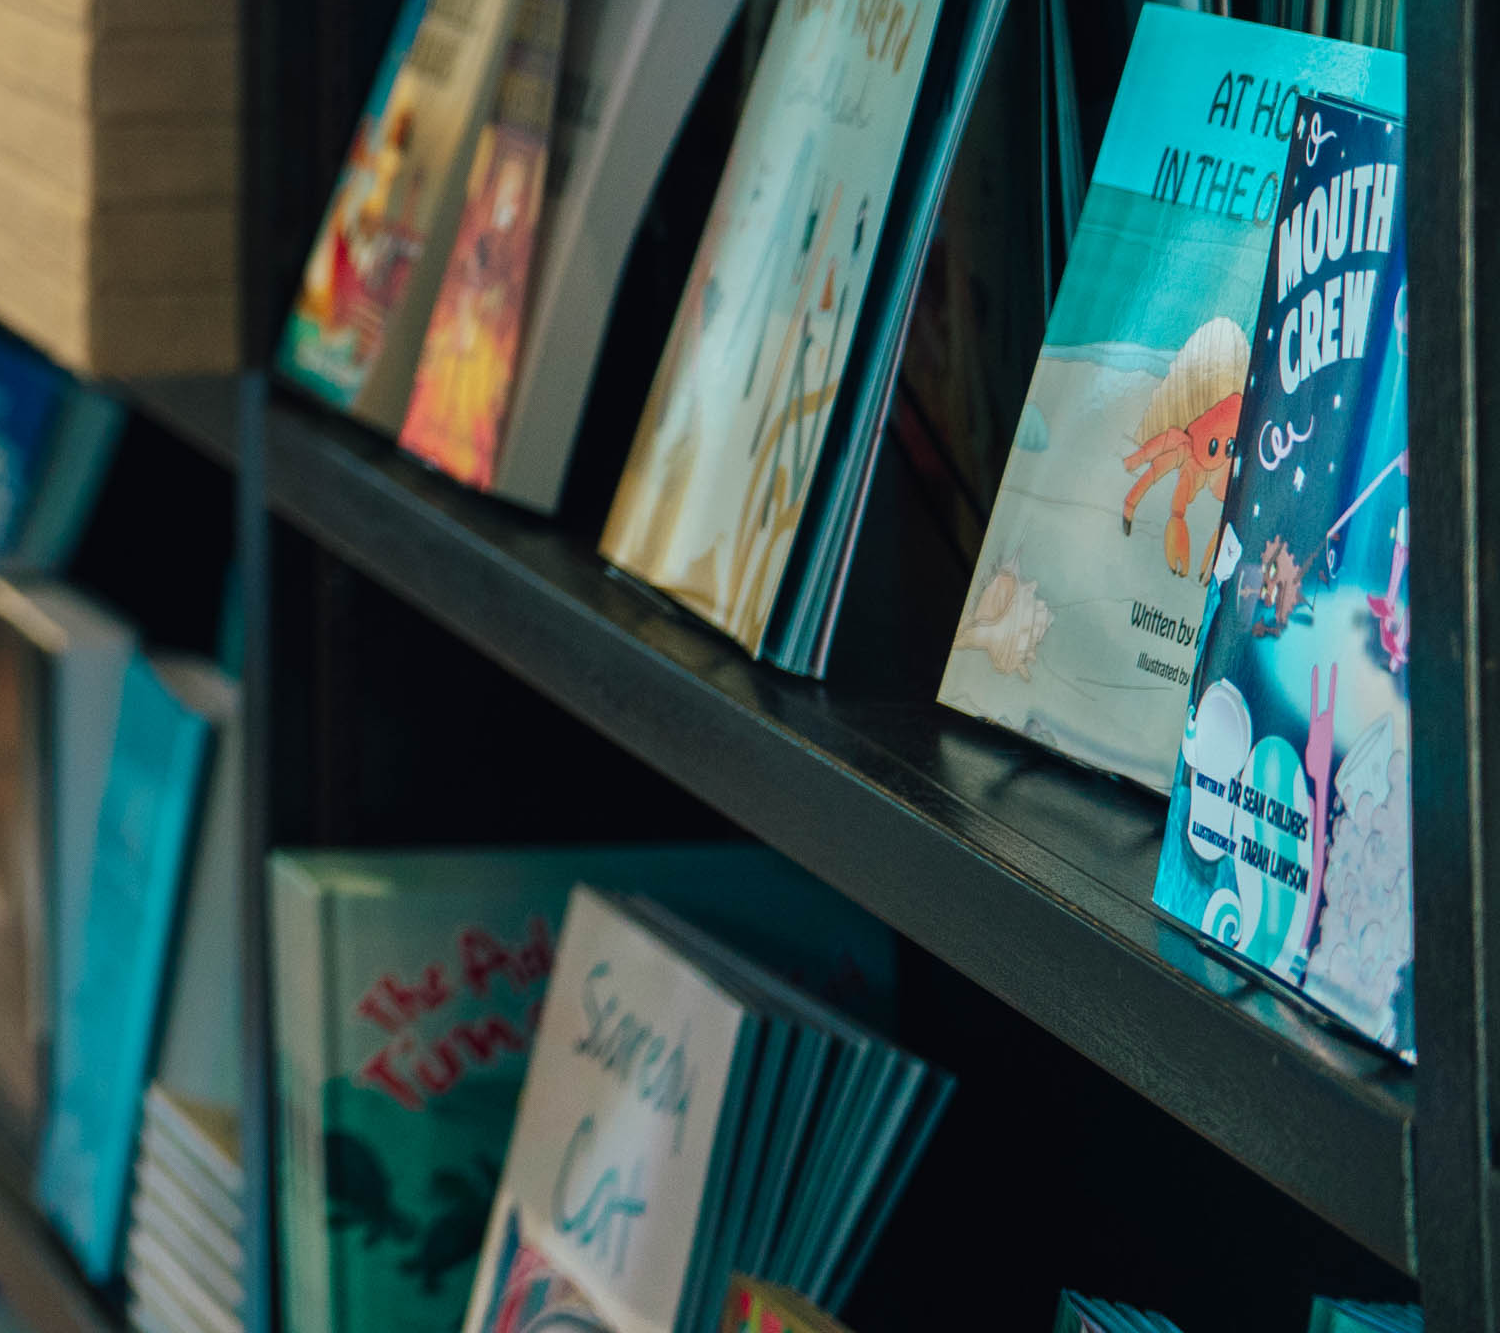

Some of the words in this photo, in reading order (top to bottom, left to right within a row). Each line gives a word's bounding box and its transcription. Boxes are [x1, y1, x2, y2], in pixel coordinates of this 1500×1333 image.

[1208, 70, 1254, 129] AT
[1251, 77, 1301, 142] HO
[1152, 146, 1191, 205] IN
[1190, 153, 1256, 217] THE
[1253, 171, 1279, 229] O
[1277, 162, 1398, 303] MOUTH
[1278, 269, 1377, 395] CREW
[1131, 600, 1176, 641] Written
[1177, 616, 1195, 646] by
[1136, 651, 1179, 682] Illustrated
[1179, 667, 1191, 686] by
[1227, 777, 1242, 807] DR
[1242, 785, 1267, 820] SEAN
[1266, 797, 1308, 842] CHILDERS
[1241, 835, 1271, 874] TARAH
[1269, 851, 1309, 894] LAWSON
[551, 1112, 647, 1273] Cat
